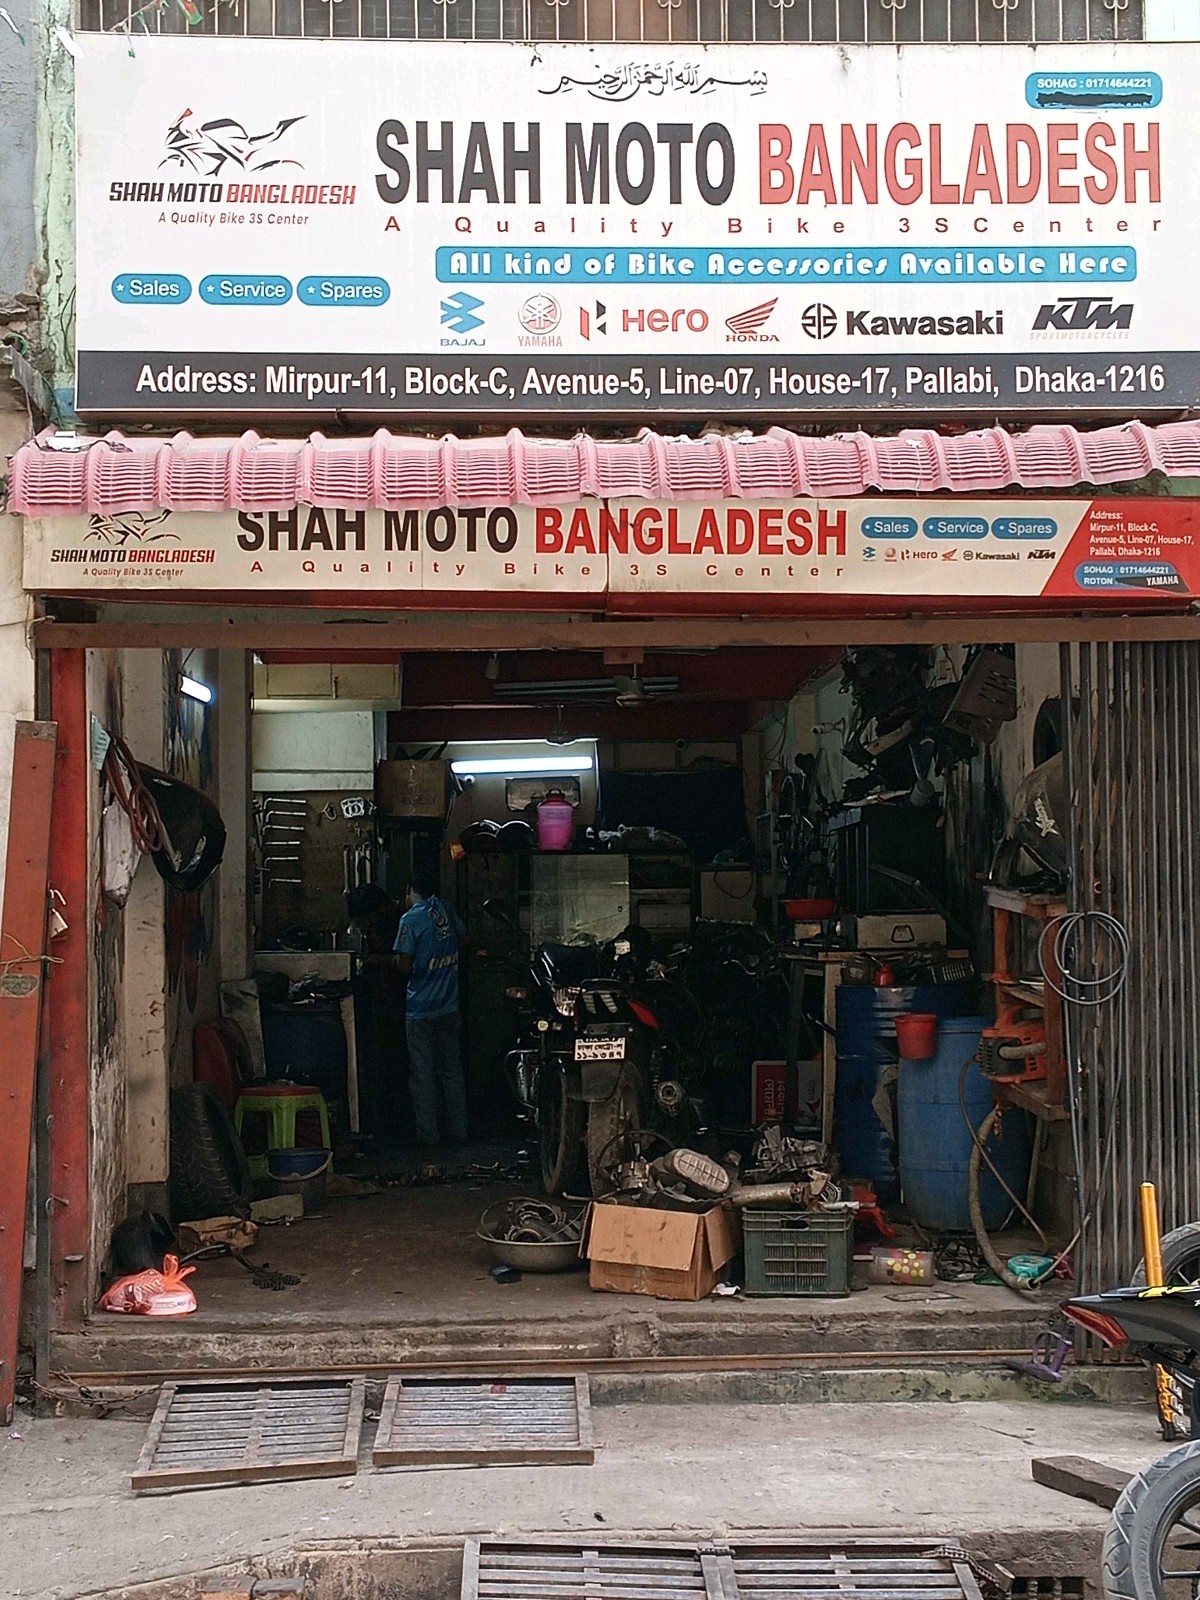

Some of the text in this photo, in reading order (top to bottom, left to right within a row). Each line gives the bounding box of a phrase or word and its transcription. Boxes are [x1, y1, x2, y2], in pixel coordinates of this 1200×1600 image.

[1037, 78, 1078, 88] SOHAG
[375, 118, 1162, 206] SHAH MOTO BANGLADESH
[110, 182, 357, 205] SHAH MOTO BANGLADESH
[158, 211, 309, 227] A Quality Bike 3S Center
[384, 216, 401, 232] A
[455, 216, 674, 237] Quality
[727, 217, 845, 234] Bike
[451, 251, 1129, 276] All kind of Bike Accessories Available Here
[129, 279, 180, 297] Sales
[219, 280, 286, 298] Service
[320, 281, 383, 302] Spares
[1031, 296, 1134, 331] KTM
[622, 308, 709, 333] Hero
[846, 310, 1004, 337] Kawasaki
[440, 338, 486, 347] BAJAJ
[517, 335, 563, 348] YAMAHA
[725, 334, 780, 343] HONDA
[1029, 331, 1131, 341] SPORTMOTORCYCLES
[135, 364, 1165, 400] Address: Mirpur-11, Block-C, Avenue-5, Line-07, House-17, Pallabi, Dhaka-1216
[1090, 511, 1123, 520] Address:
[236, 506, 847, 556] SHAH MOTO BANGLADESH
[874, 521, 909, 533] Sales
[937, 522, 983, 534] Service
[1008, 522, 1052, 537] Spares
[1090, 523, 1159, 533] Mirpur-11, Block-C,
[1090, 535, 1194, 546] Avenue-5, Line-07, House-17,
[51, 550, 216, 563] SHAH MOTO BANGLADESH
[975, 552, 1019, 560] Kawasaki
[1027, 549, 1056, 559] KTM
[1090, 547, 1161, 557] Pallabi, Dhaka-1216
[83, 568, 183, 578] A Quality Bike 3S Center
[250, 561, 843, 577] A Quality Bike 3S Center
[1083, 566, 1114, 574] SOHAG
[1146, 576, 1180, 586] YAMAHA
